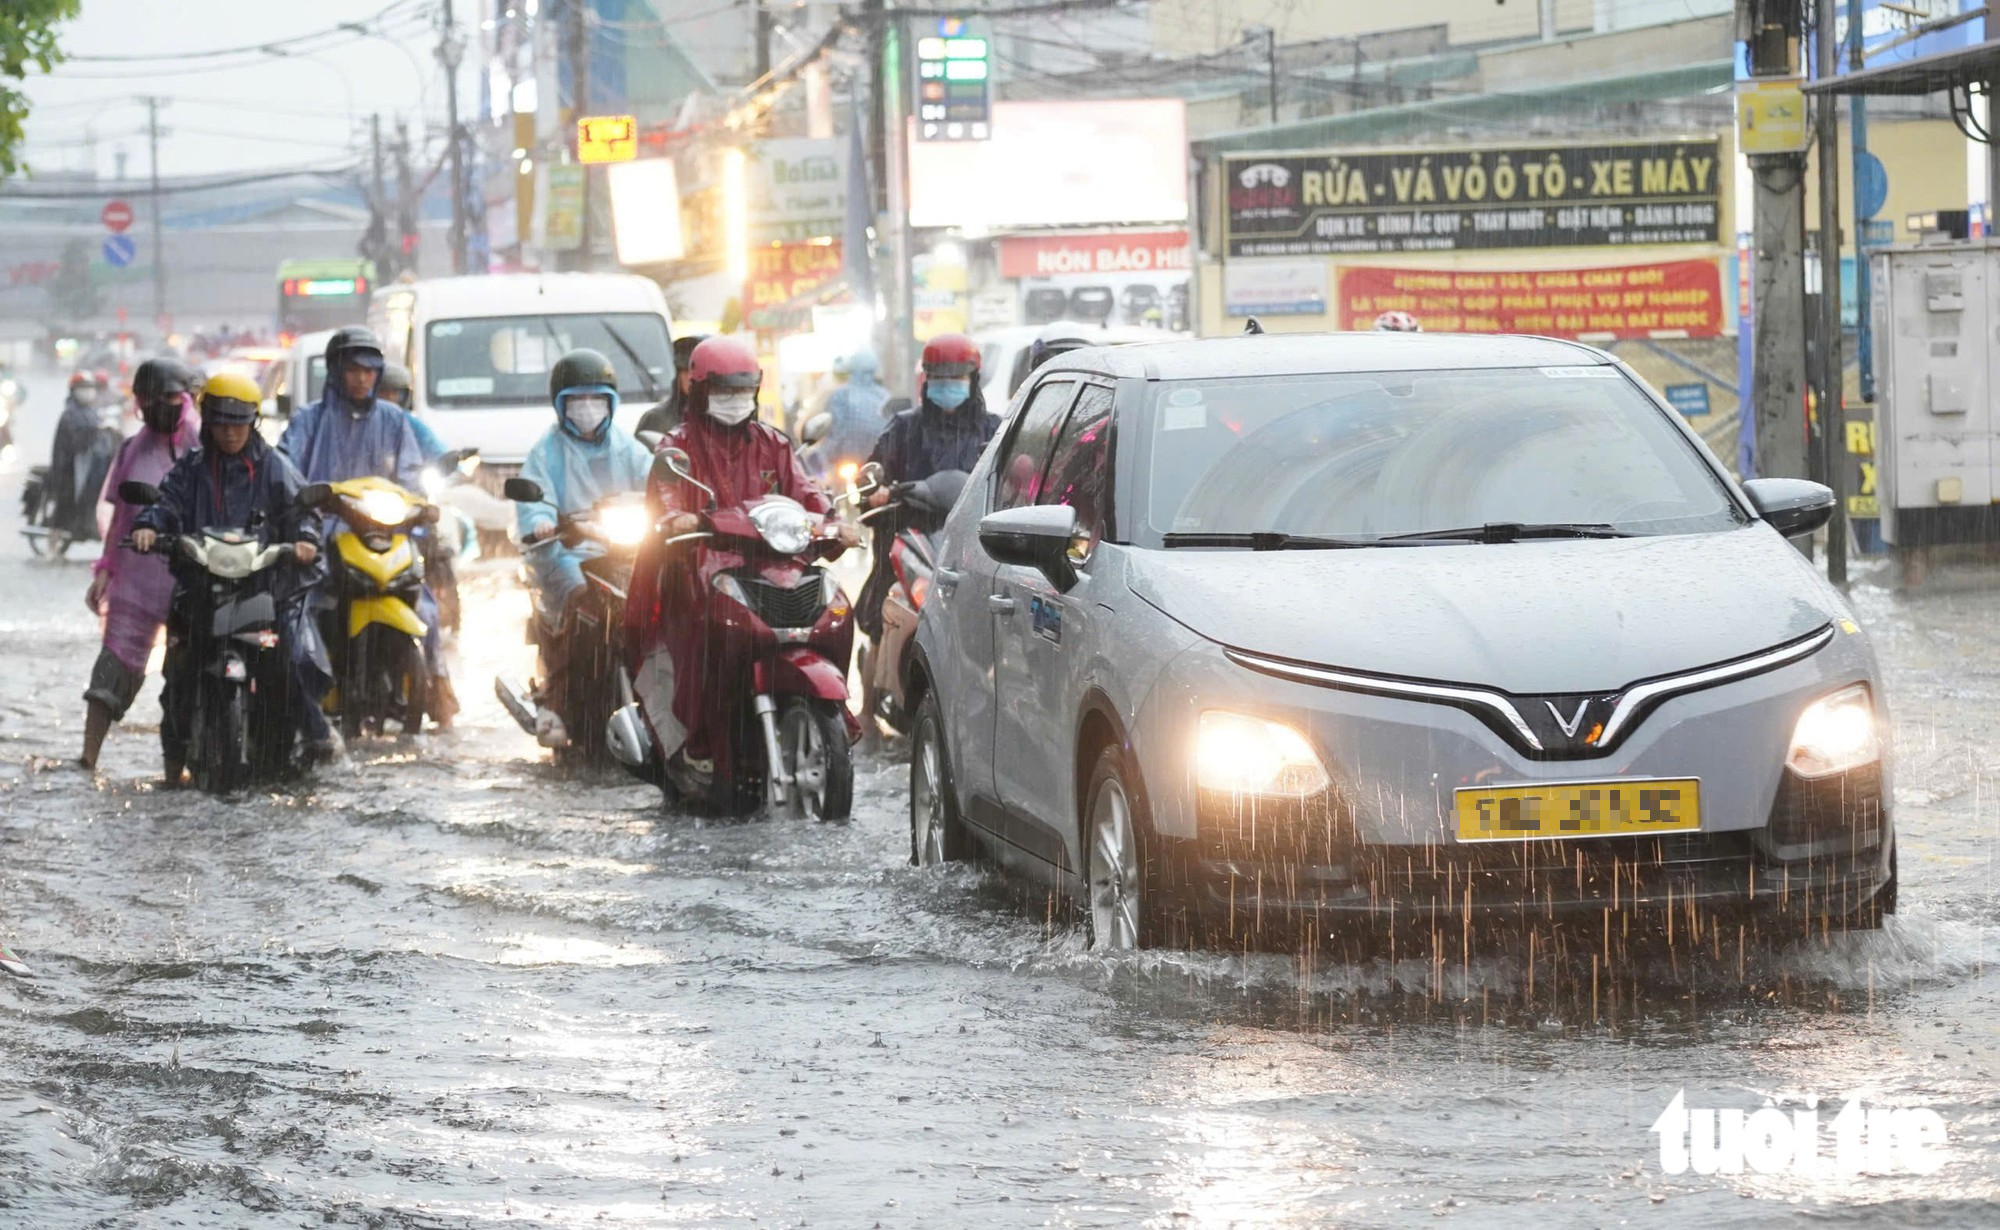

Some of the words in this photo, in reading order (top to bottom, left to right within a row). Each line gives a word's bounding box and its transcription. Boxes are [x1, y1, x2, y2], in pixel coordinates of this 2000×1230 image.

[1302, 157, 1369, 205] RỬA
[1391, 156, 1436, 202] VÁ
[1442, 151, 1487, 200] VỎ
[1493, 154, 1517, 200] Ô
[1522, 152, 1567, 198] TÔ
[1590, 158, 1634, 196] XE
[1641, 147, 1712, 194] MÁY
[1037, 245, 1091, 272] NÓN
[1096, 244, 1150, 271] BẢO
